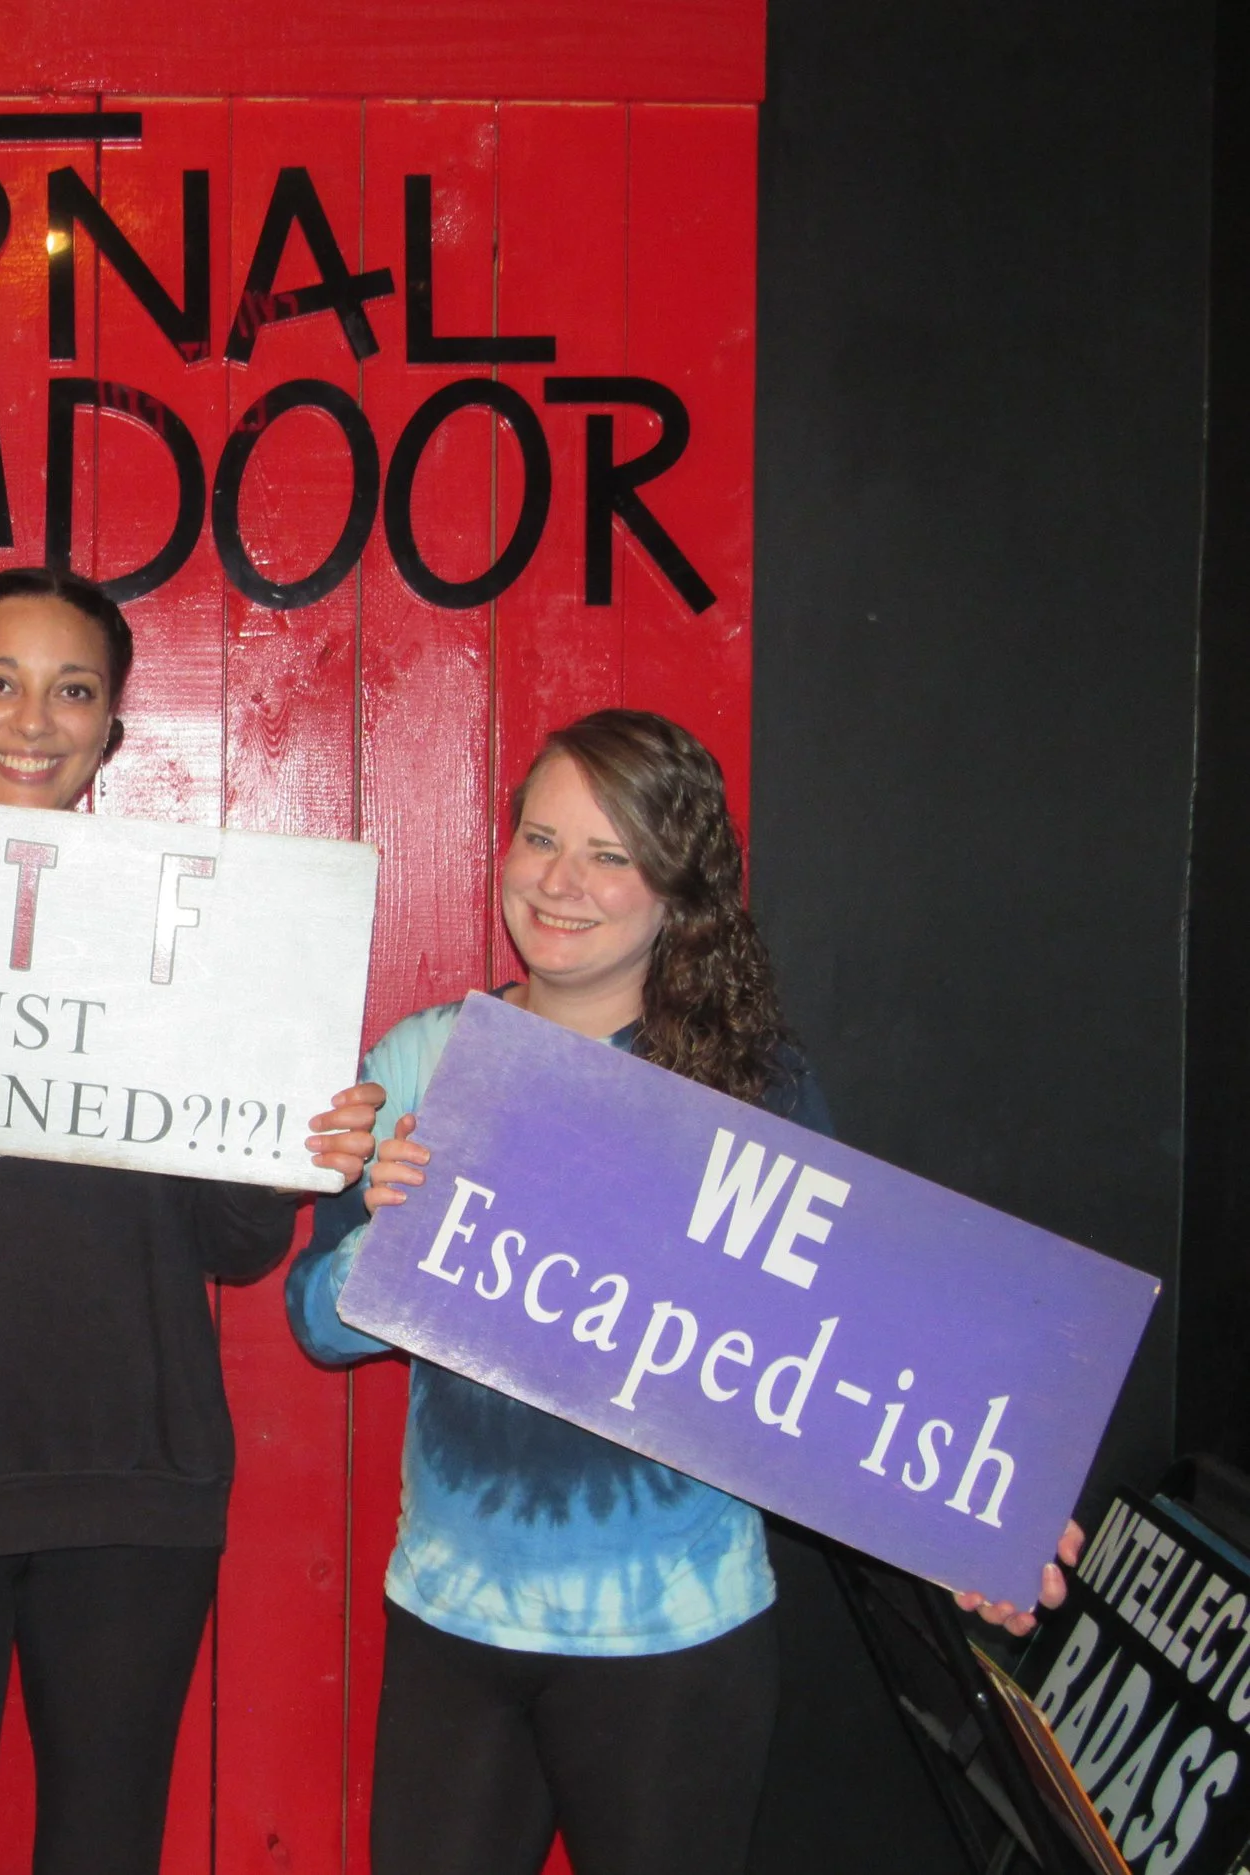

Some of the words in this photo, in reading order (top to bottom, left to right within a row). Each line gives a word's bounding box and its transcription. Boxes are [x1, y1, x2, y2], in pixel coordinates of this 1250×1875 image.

[46, 376, 717, 615] DOOR
[686, 1127, 852, 1290] WE
[417, 1177, 1017, 1529] Escaped-ish
[1077, 1497, 1250, 1734] INTELLECT
[1031, 1613, 1238, 1875] BADASS
